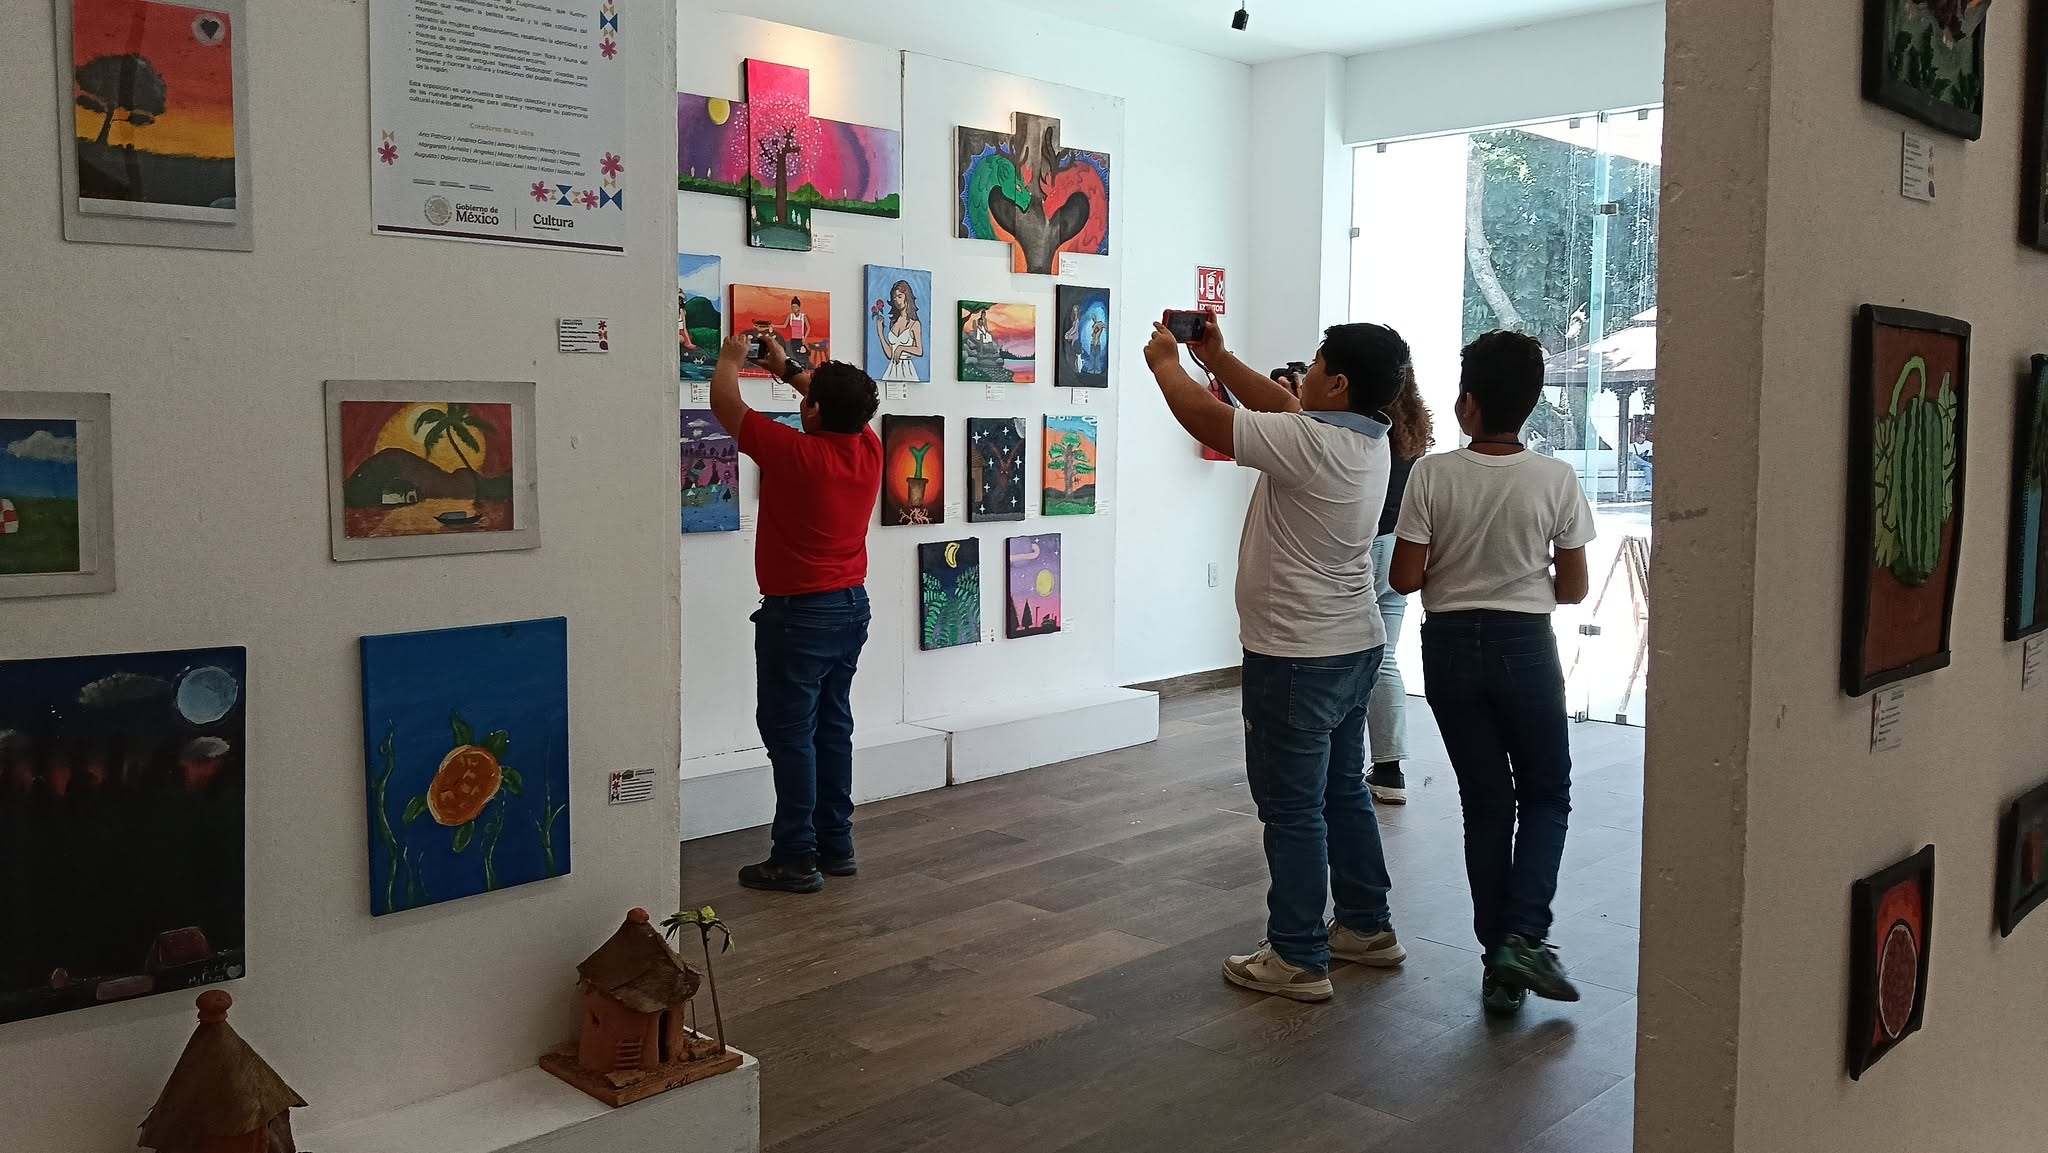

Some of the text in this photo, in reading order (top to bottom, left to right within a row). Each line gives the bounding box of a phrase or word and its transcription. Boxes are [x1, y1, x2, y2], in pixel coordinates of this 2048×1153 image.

[455, 203, 499, 214] Gobierno de
[455, 210, 499, 225] México
[533, 214, 574, 228] Cultura
